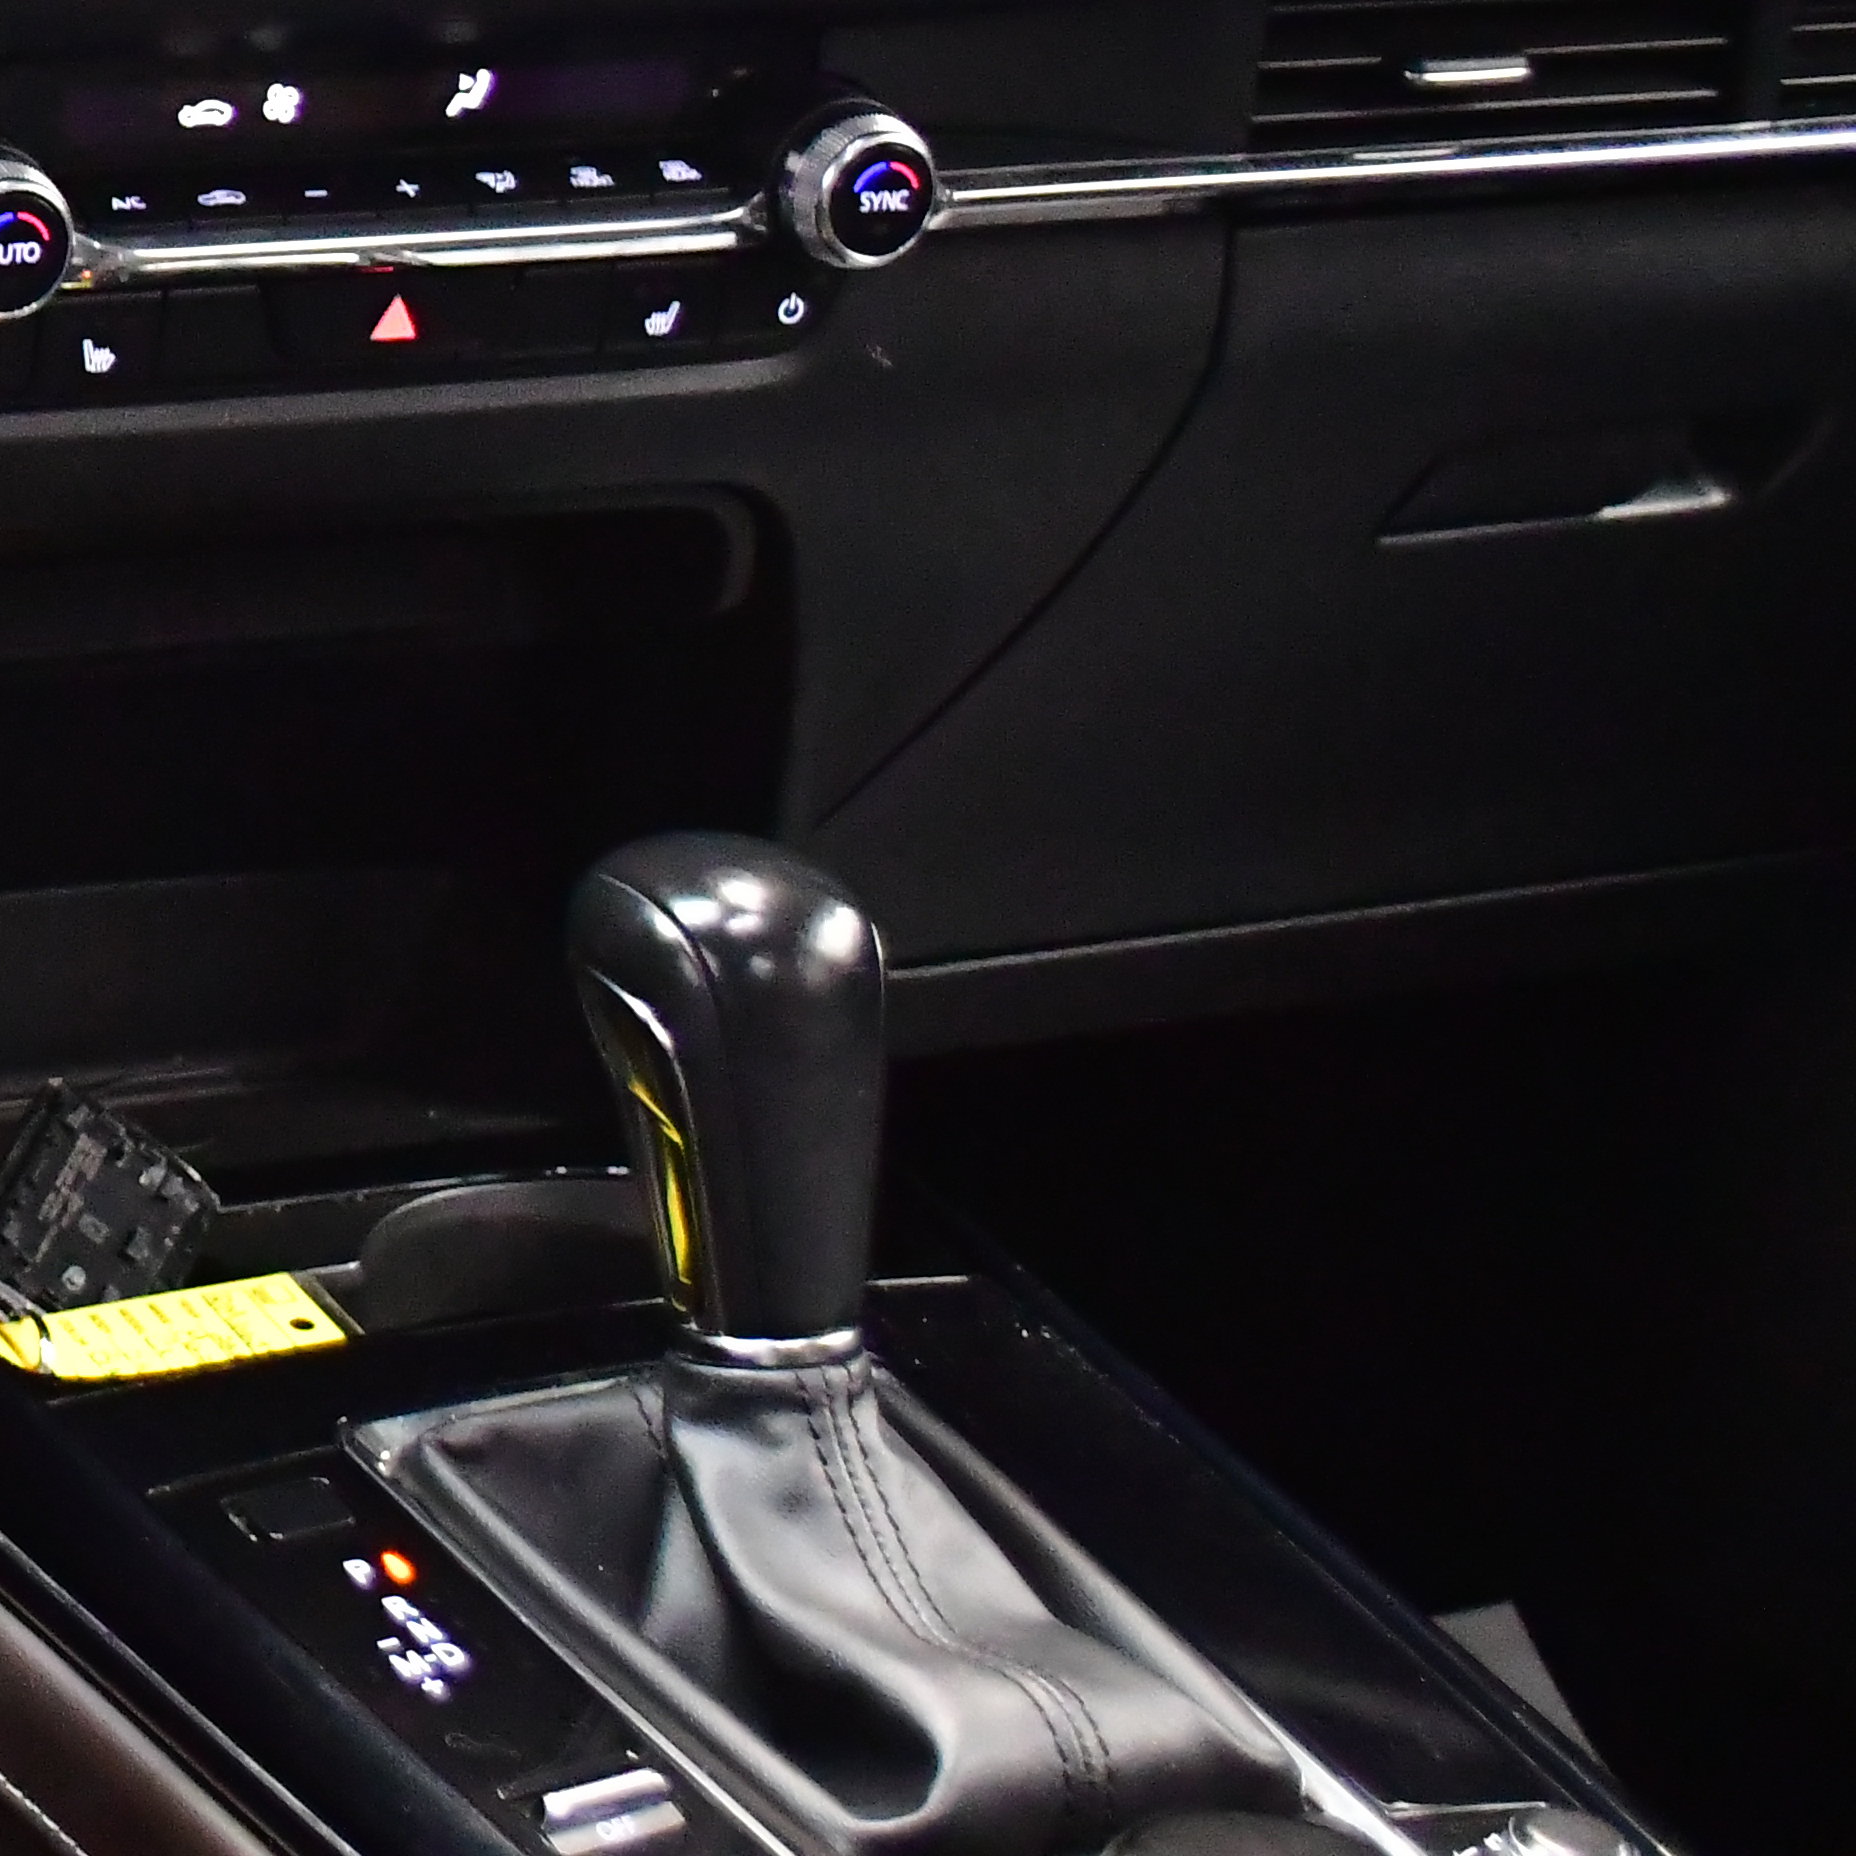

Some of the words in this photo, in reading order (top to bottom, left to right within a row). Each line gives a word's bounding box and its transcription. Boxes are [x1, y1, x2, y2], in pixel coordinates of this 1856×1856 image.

[858, 188, 911, 213] SYNC
[342, 1558, 372, 1585] P
[381, 1595, 420, 1621] R
[406, 1617, 444, 1644] N
